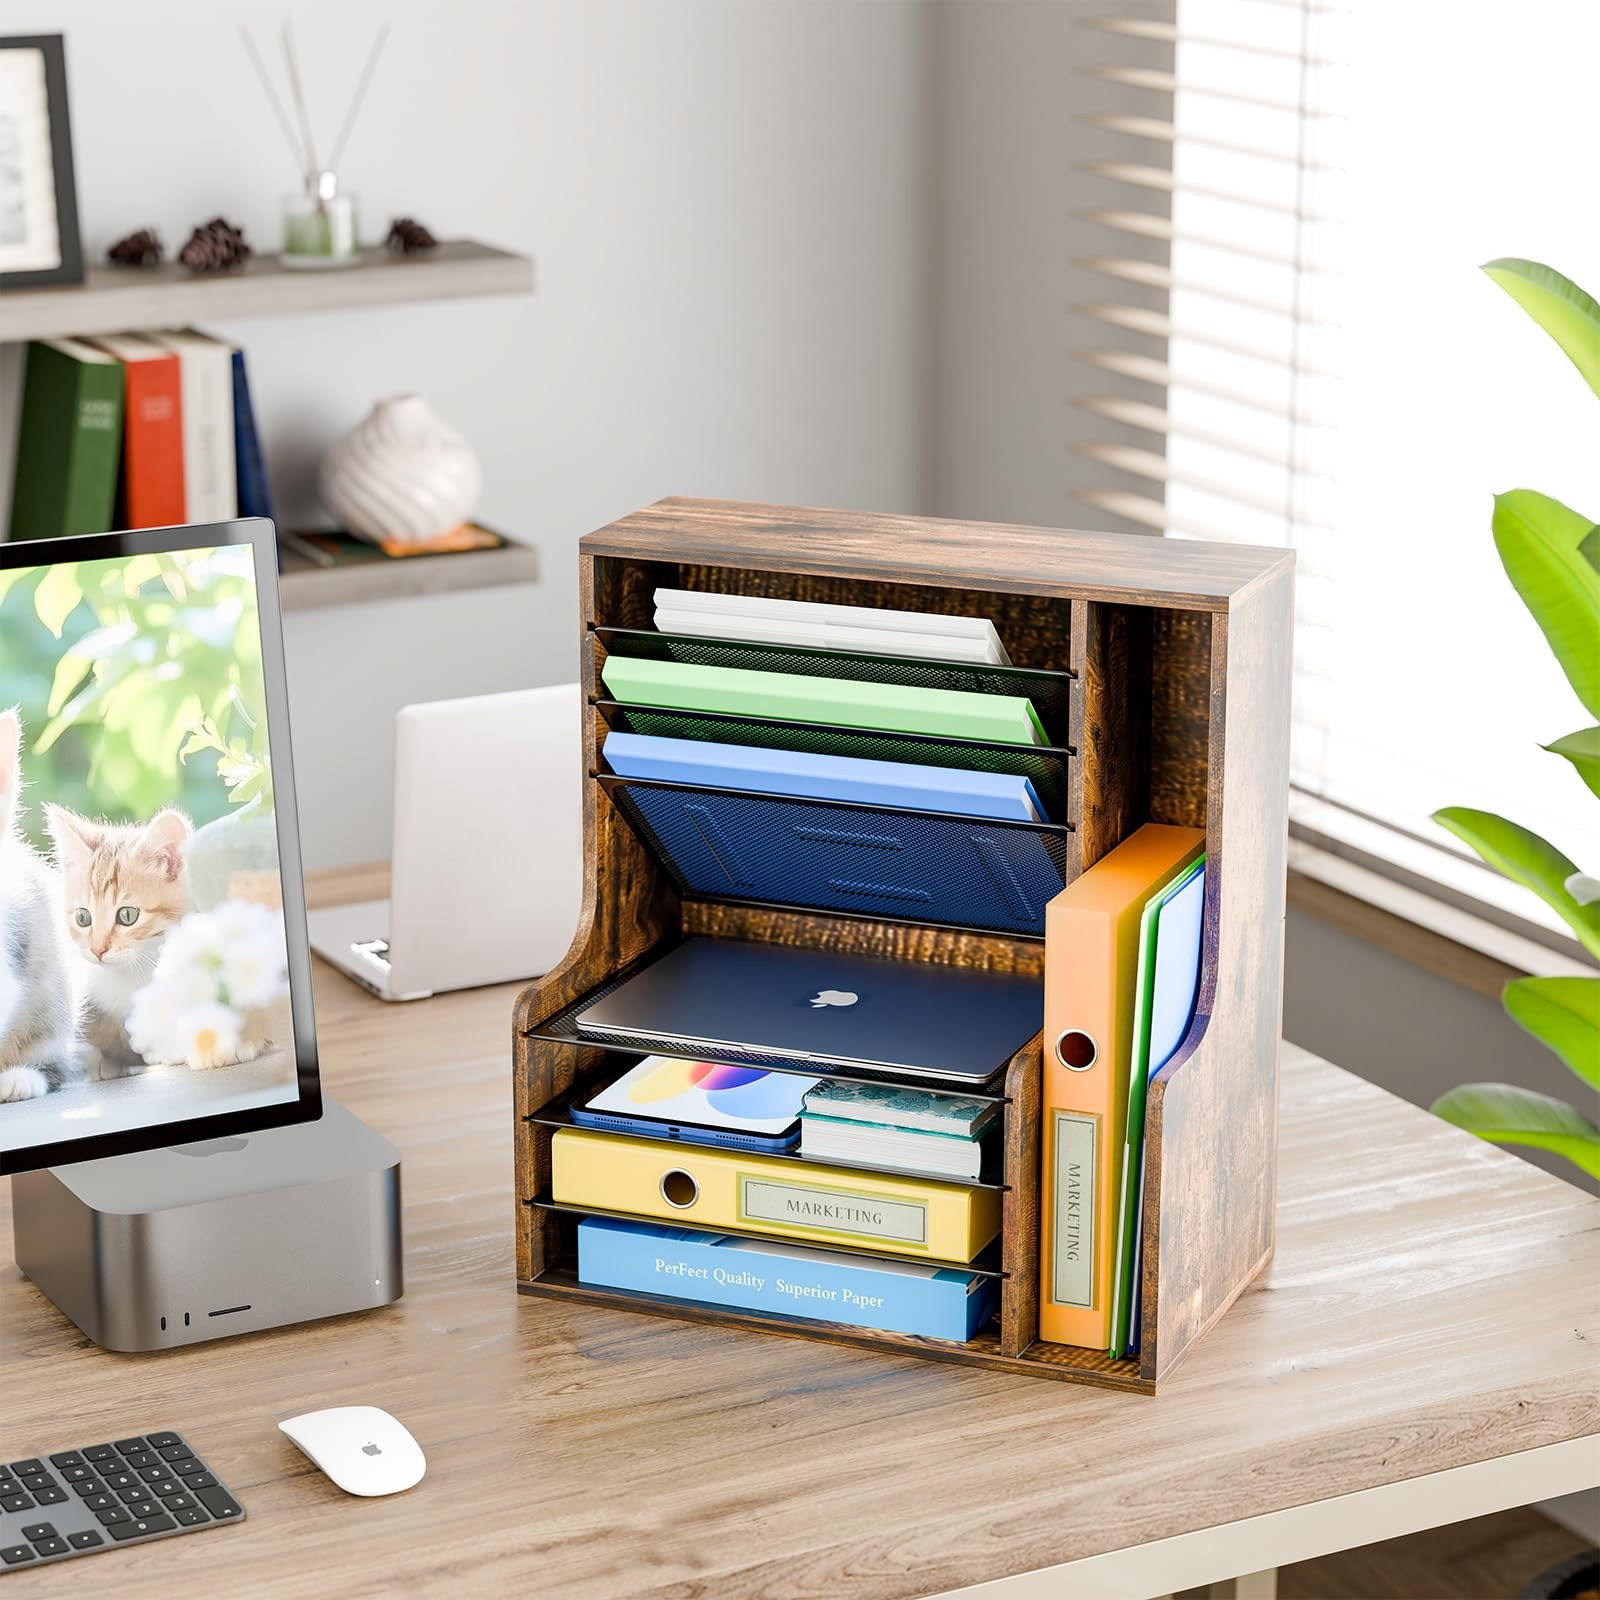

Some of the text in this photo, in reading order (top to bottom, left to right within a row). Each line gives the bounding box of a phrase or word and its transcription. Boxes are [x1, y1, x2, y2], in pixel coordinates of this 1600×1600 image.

[787, 1199, 882, 1225] MARKETING
[1067, 1163, 1080, 1262] MARKETING
[713, 1267, 765, 1291] Quality
[776, 1278, 838, 1301] Superior
[842, 1288, 884, 1310] Paper
